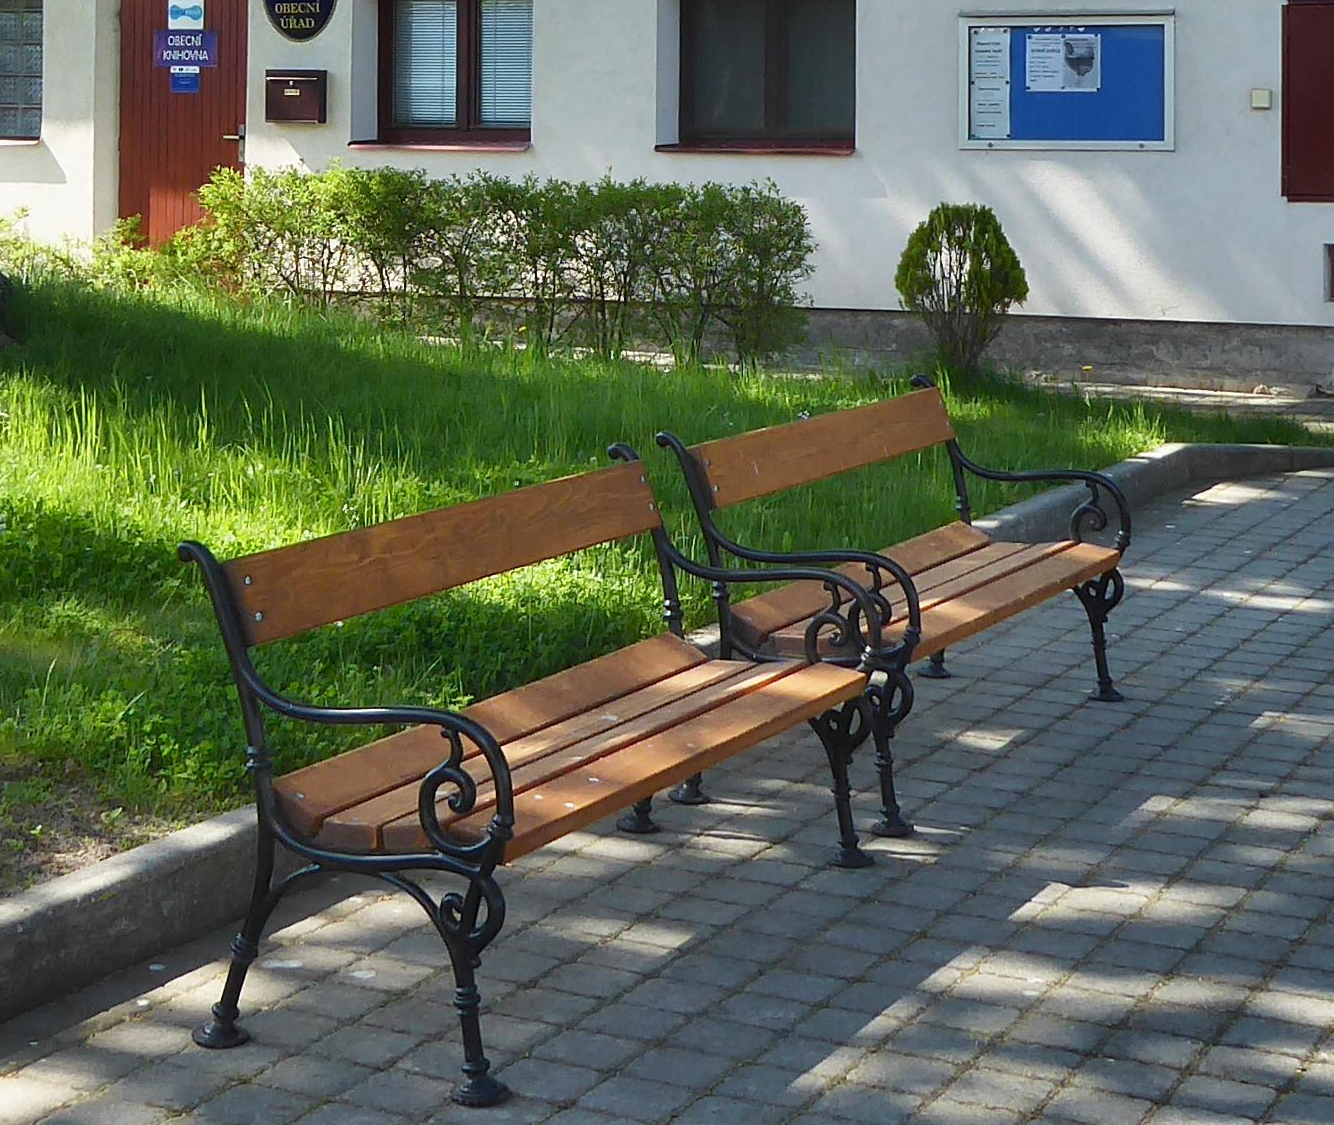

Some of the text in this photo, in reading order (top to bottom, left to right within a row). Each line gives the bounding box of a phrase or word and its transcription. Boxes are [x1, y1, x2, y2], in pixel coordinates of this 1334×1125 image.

[275, 0, 320, 14] OBECNÍ
[280, 15, 315, 29] ÚŘAD
[167, 34, 203, 46] OBECNÍ
[162, 49, 209, 61] KNIHOVNA
